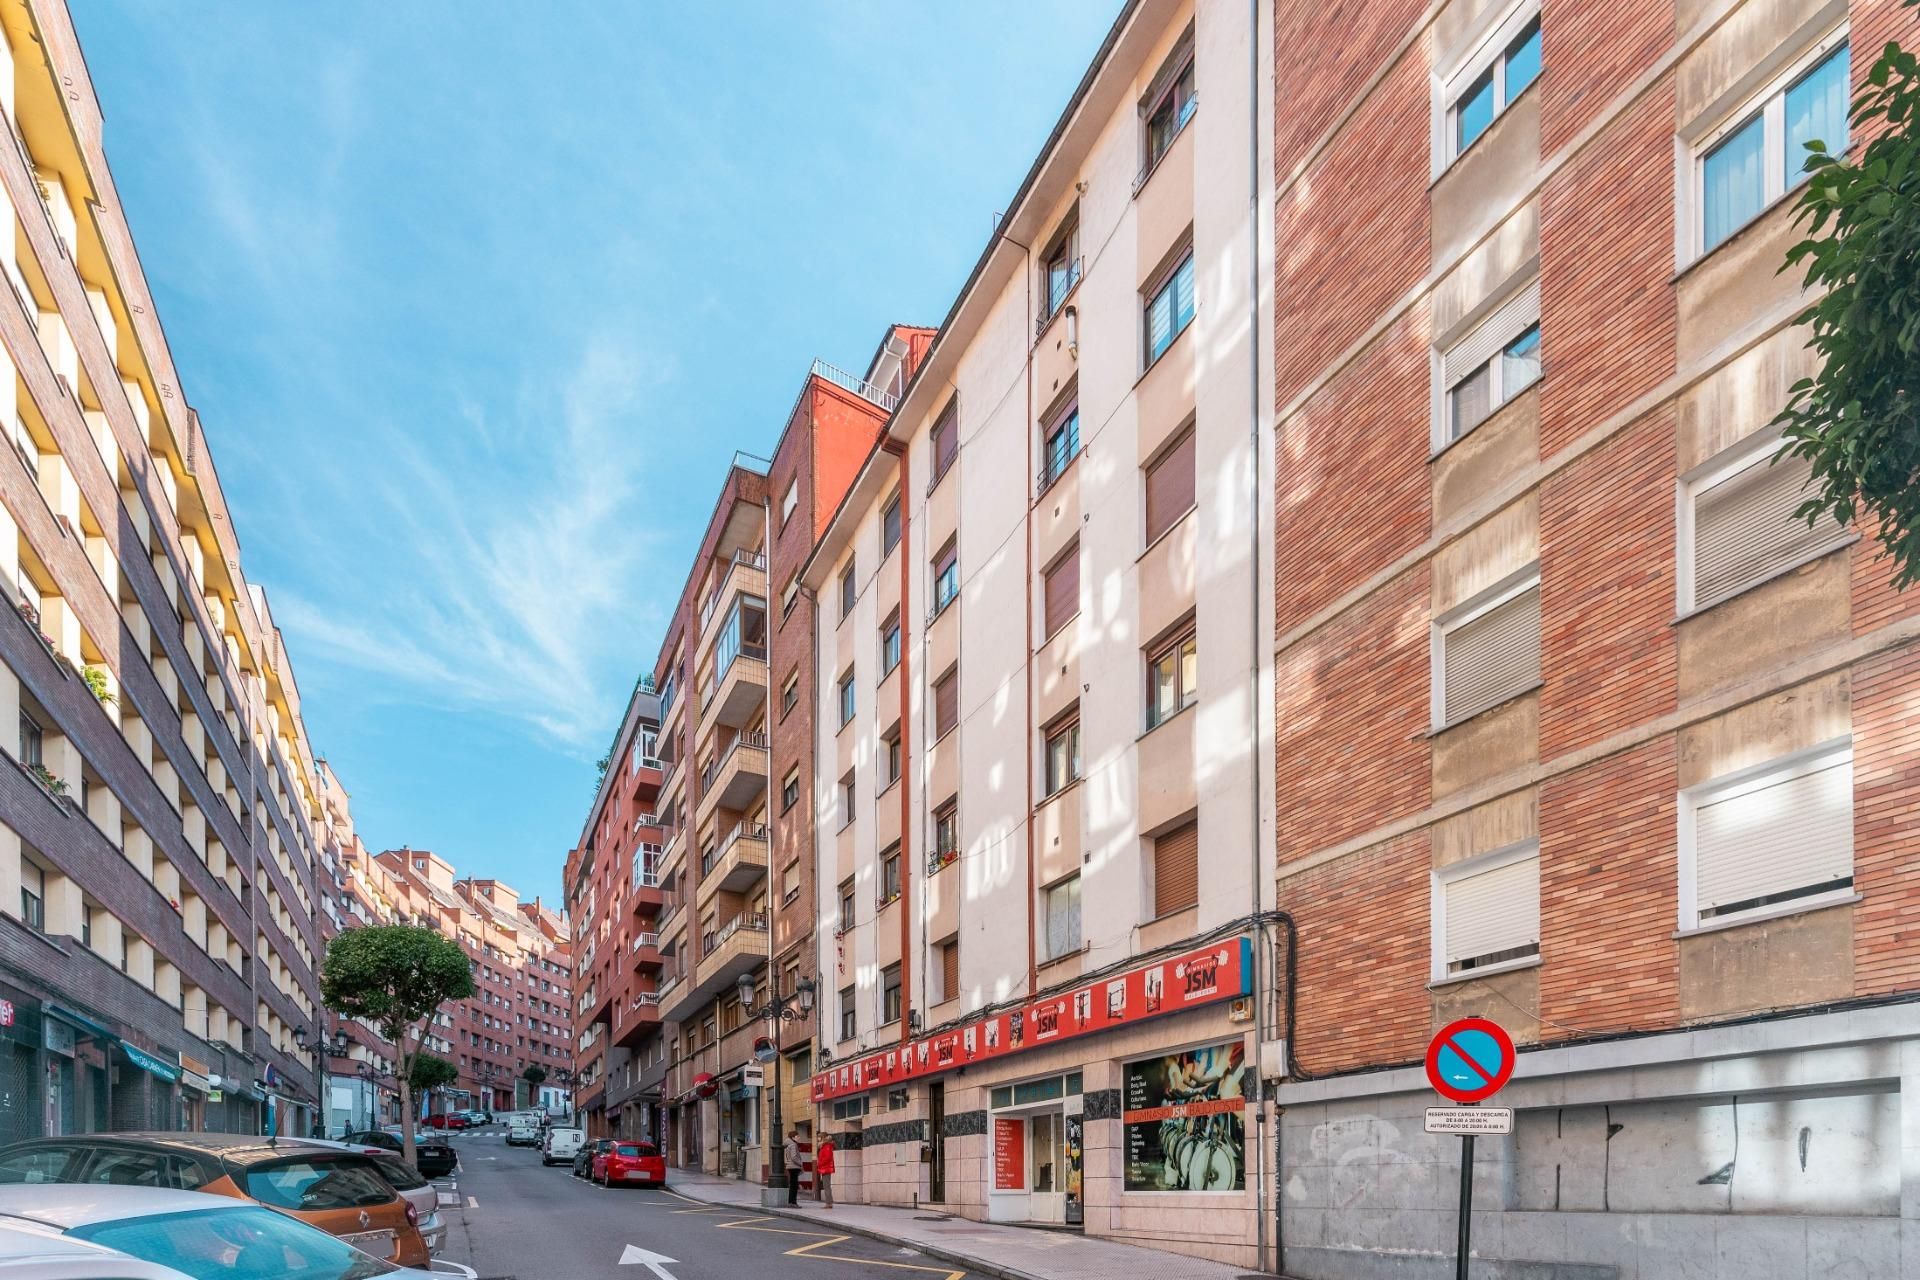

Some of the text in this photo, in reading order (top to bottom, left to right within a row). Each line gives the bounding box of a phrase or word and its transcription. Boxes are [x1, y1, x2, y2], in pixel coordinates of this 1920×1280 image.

[1184, 967, 1217, 994] JSM
[0, 1004, 14, 1025] er
[1037, 1014, 1058, 1035] JSM
[1133, 1099, 1241, 1121] GIMNASIO JSM BAJO COSTE
